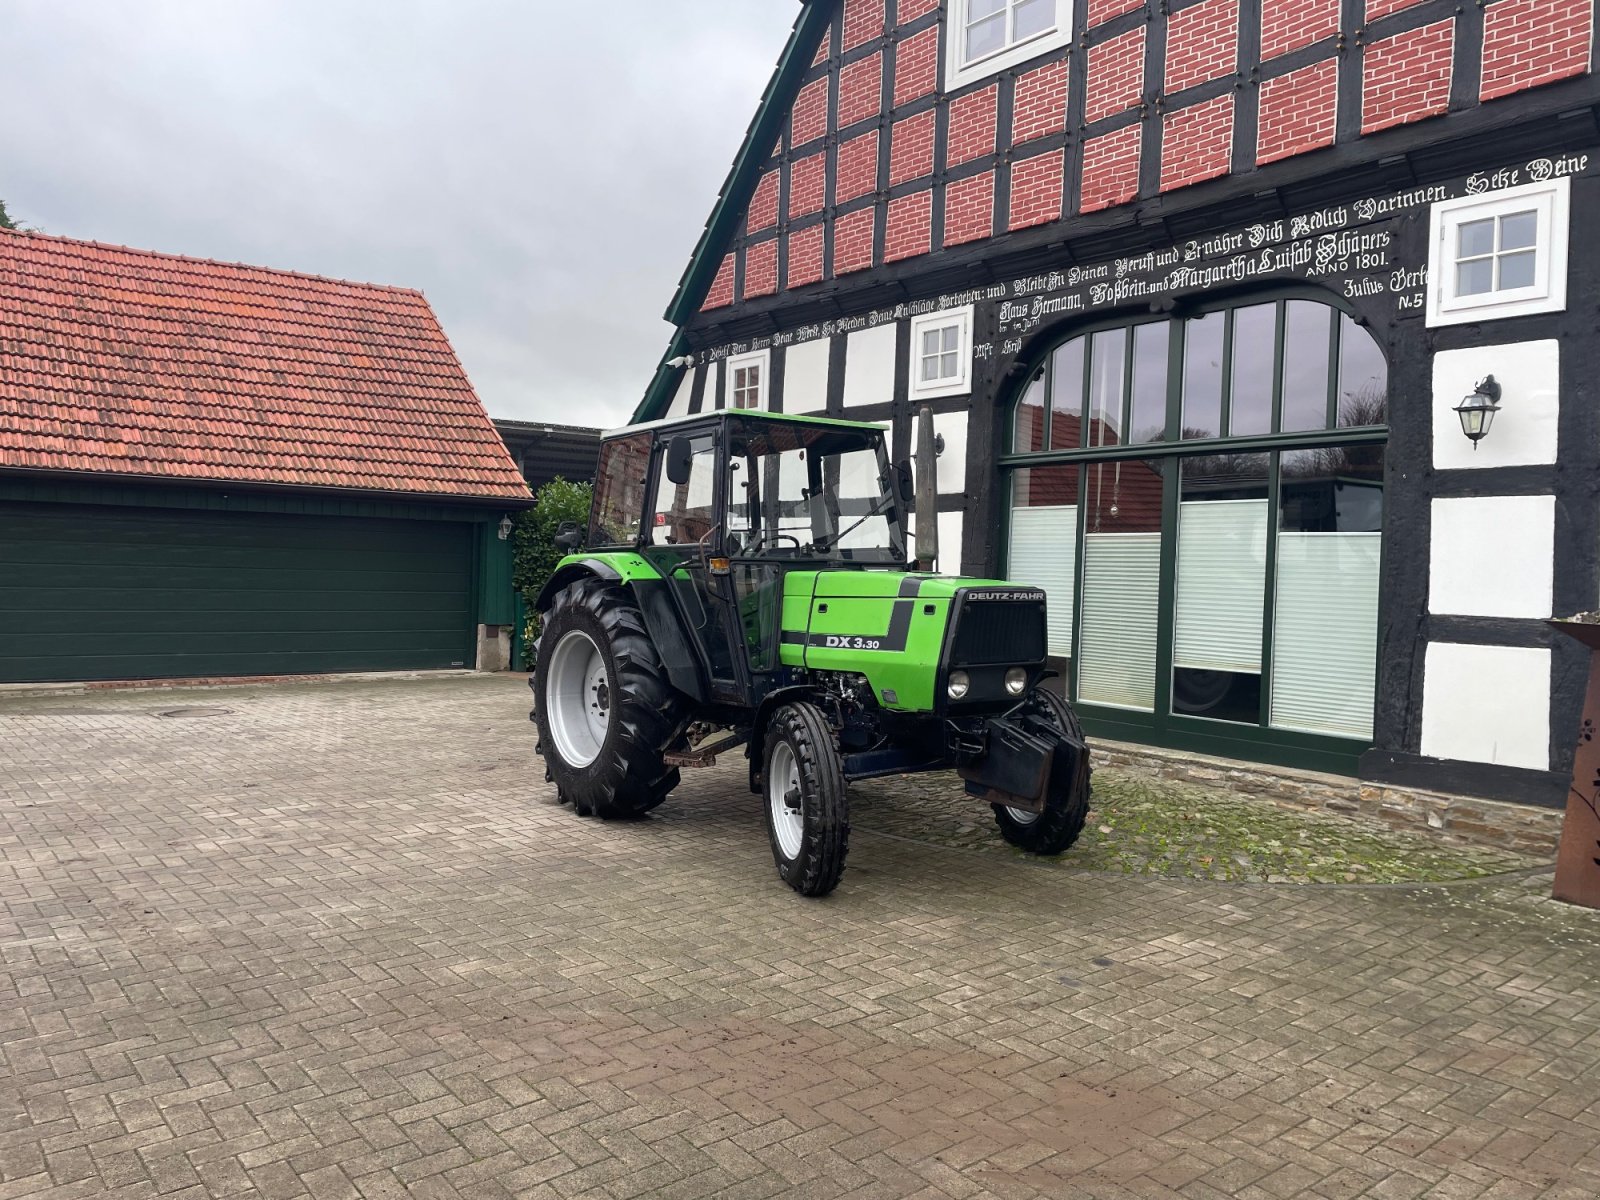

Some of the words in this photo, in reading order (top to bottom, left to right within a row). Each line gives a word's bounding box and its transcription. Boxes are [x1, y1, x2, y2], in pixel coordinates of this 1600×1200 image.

[987, 283, 1006, 298] und
[1157, 246, 1179, 266] und
[1525, 155, 1588, 183] Deine
[1306, 262, 1348, 277] ANNO
[1344, 277, 1384, 297] Julius
[968, 592, 1044, 600] DEUTZ-FAHR
[826, 636, 851, 648] DX
[853, 637, 880, 649] 3.30
